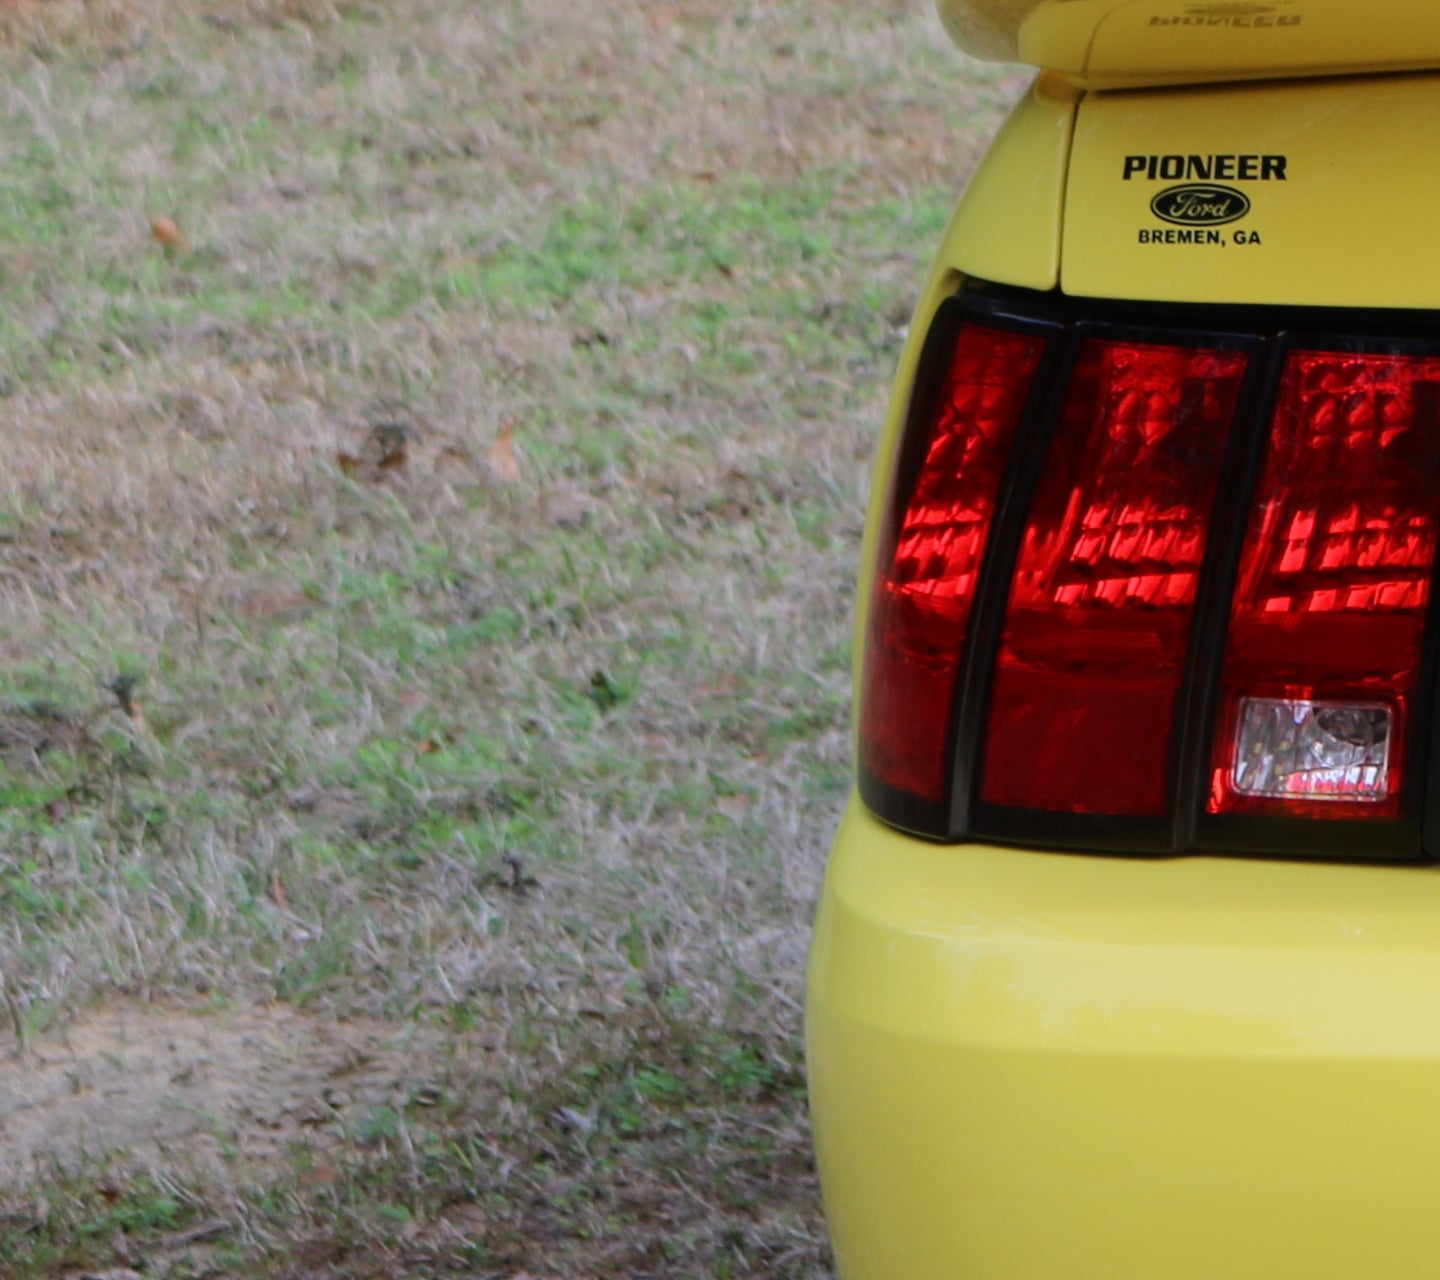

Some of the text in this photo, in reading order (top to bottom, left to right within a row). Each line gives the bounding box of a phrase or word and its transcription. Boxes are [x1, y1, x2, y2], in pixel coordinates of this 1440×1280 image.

[1123, 155, 1287, 181] PIONEER
[1169, 192, 1230, 217] Ford
[1139, 230, 1261, 247] BREMEN, GA
